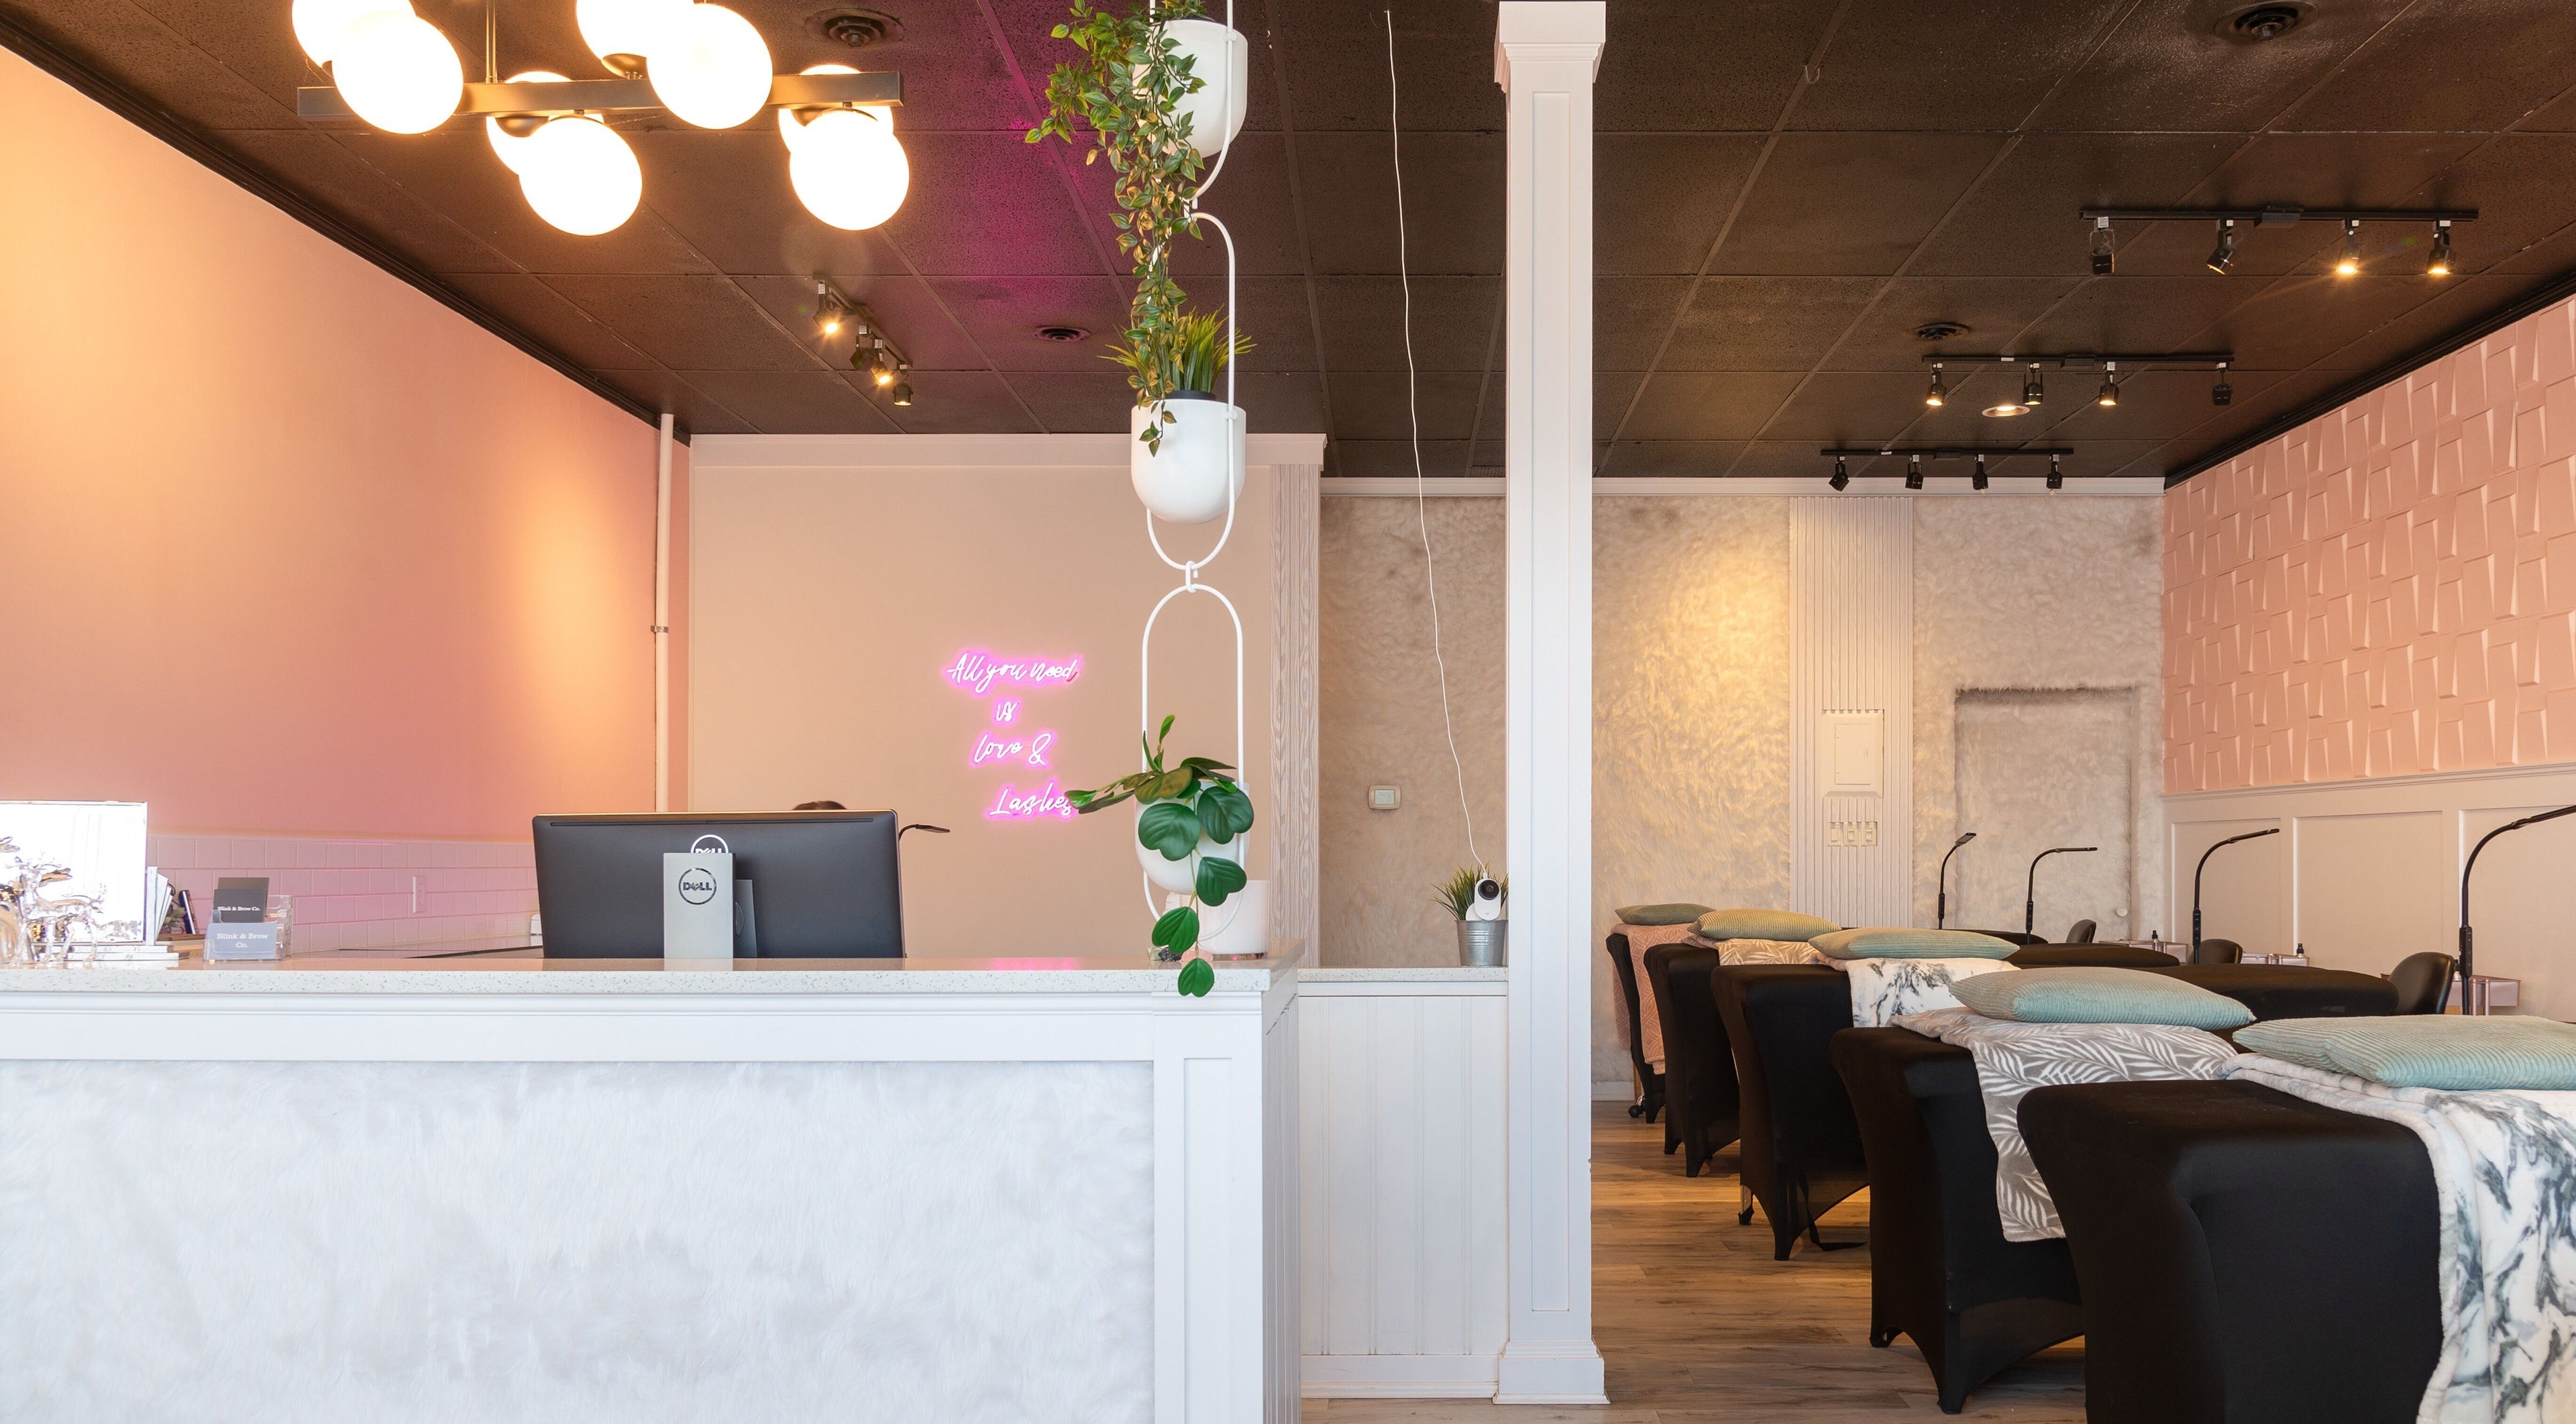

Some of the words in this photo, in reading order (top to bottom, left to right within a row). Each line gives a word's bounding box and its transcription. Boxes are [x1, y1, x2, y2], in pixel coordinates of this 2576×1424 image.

[947, 652, 984, 684] All
[975, 662, 1028, 694] you
[995, 701, 1020, 722] is
[973, 734, 1024, 763] love
[1028, 732, 1053, 766] &
[989, 782, 1072, 817] Lashes
[683, 882, 712, 891] DELL
